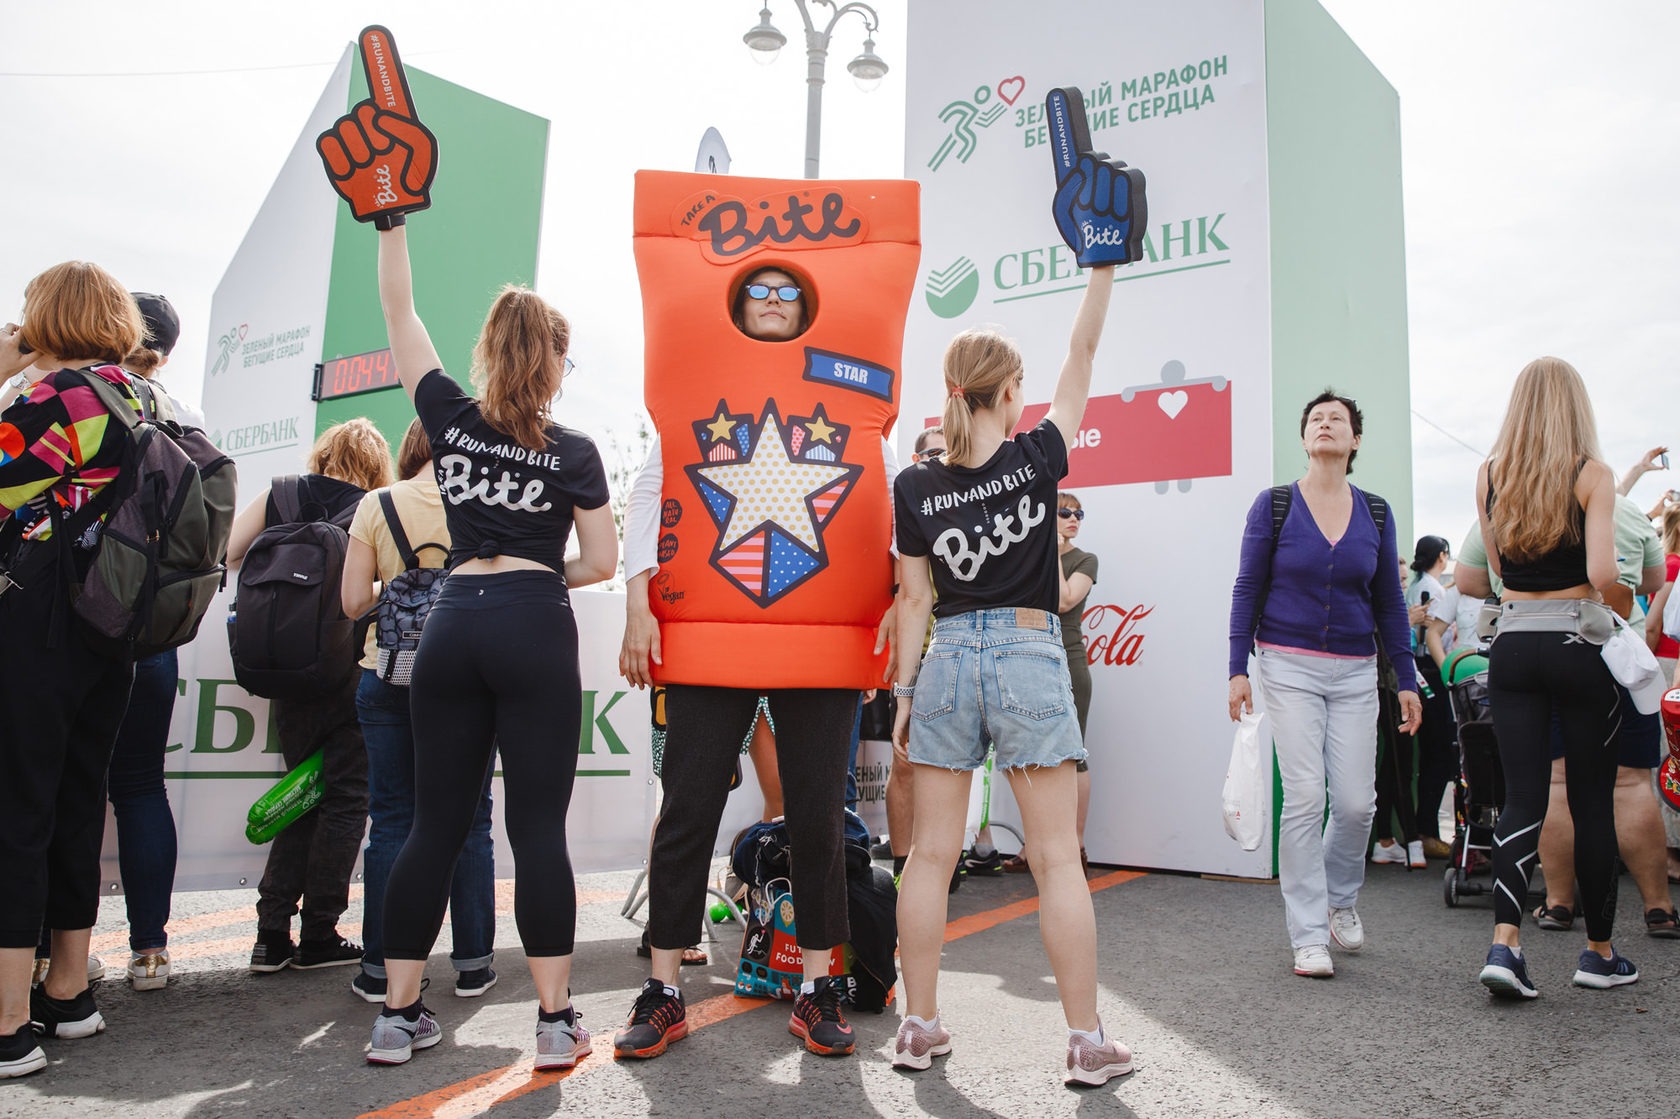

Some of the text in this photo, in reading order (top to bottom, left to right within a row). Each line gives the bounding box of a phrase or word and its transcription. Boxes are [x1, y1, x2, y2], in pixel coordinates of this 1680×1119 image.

[370, 34, 396, 108] #RUNANDBITE
[1015, 54, 1228, 128] ЗЕЛЫЙ МАРАФОН
[1024, 84, 1215, 149] БЕИЕ СЕРДЦА
[1053, 95, 1071, 168] #RUNANDBITE
[376, 164, 398, 205] Bite
[681, 194, 716, 227] TAKE A
[698, 192, 861, 257] Bite
[993, 212, 1230, 290] СБЕАНК
[1083, 224, 1123, 249] Bite
[833, 362, 868, 384] STAR
[226, 416, 299, 452] СБЕРБАНК
[444, 427, 561, 471] #RUNANDBITE
[440, 454, 552, 513] Bite
[920, 463, 1036, 516] #RUNANDBITE
[932, 494, 1046, 582] Bite
[855, 762, 883, 782] ЕНЫЙ
[858, 784, 886, 804] УЩИЕ
[775, 952, 803, 965] FOOD
